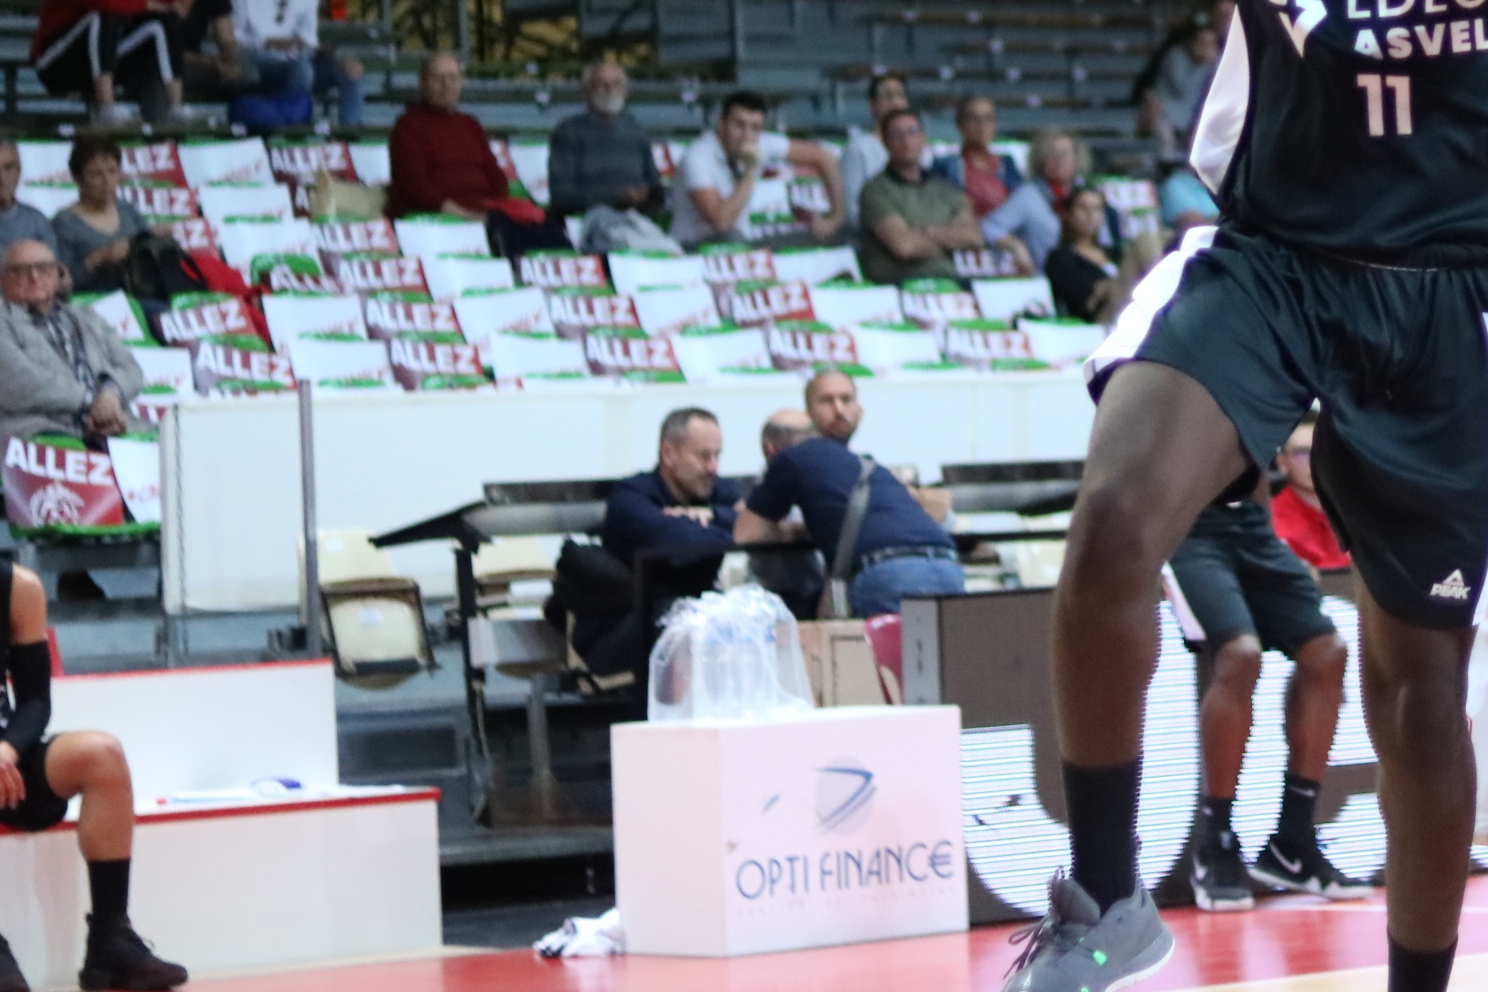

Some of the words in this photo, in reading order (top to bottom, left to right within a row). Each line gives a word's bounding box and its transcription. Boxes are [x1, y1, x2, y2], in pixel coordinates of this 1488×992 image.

[1357, 73, 1412, 137] 11
[121, 142, 175, 176] LEZ
[115, 185, 191, 215] LLEZ
[339, 258, 424, 291] ALLEZ
[521, 256, 603, 287] ALLEZ
[366, 297, 455, 332] ALLEZ
[551, 294, 635, 328] ALLEZ
[733, 280, 811, 321] ALLEZ
[160, 301, 247, 342] ALLEZ
[197, 342, 291, 382] ALLEZ
[391, 338, 479, 375] ALLEZ
[587, 335, 676, 370] ALLEZ
[769, 325, 853, 364] ALLEZ
[5, 435, 114, 486] ALLEZ
[1429, 581, 1472, 601] PEAK
[736, 854, 810, 900] OPTI
